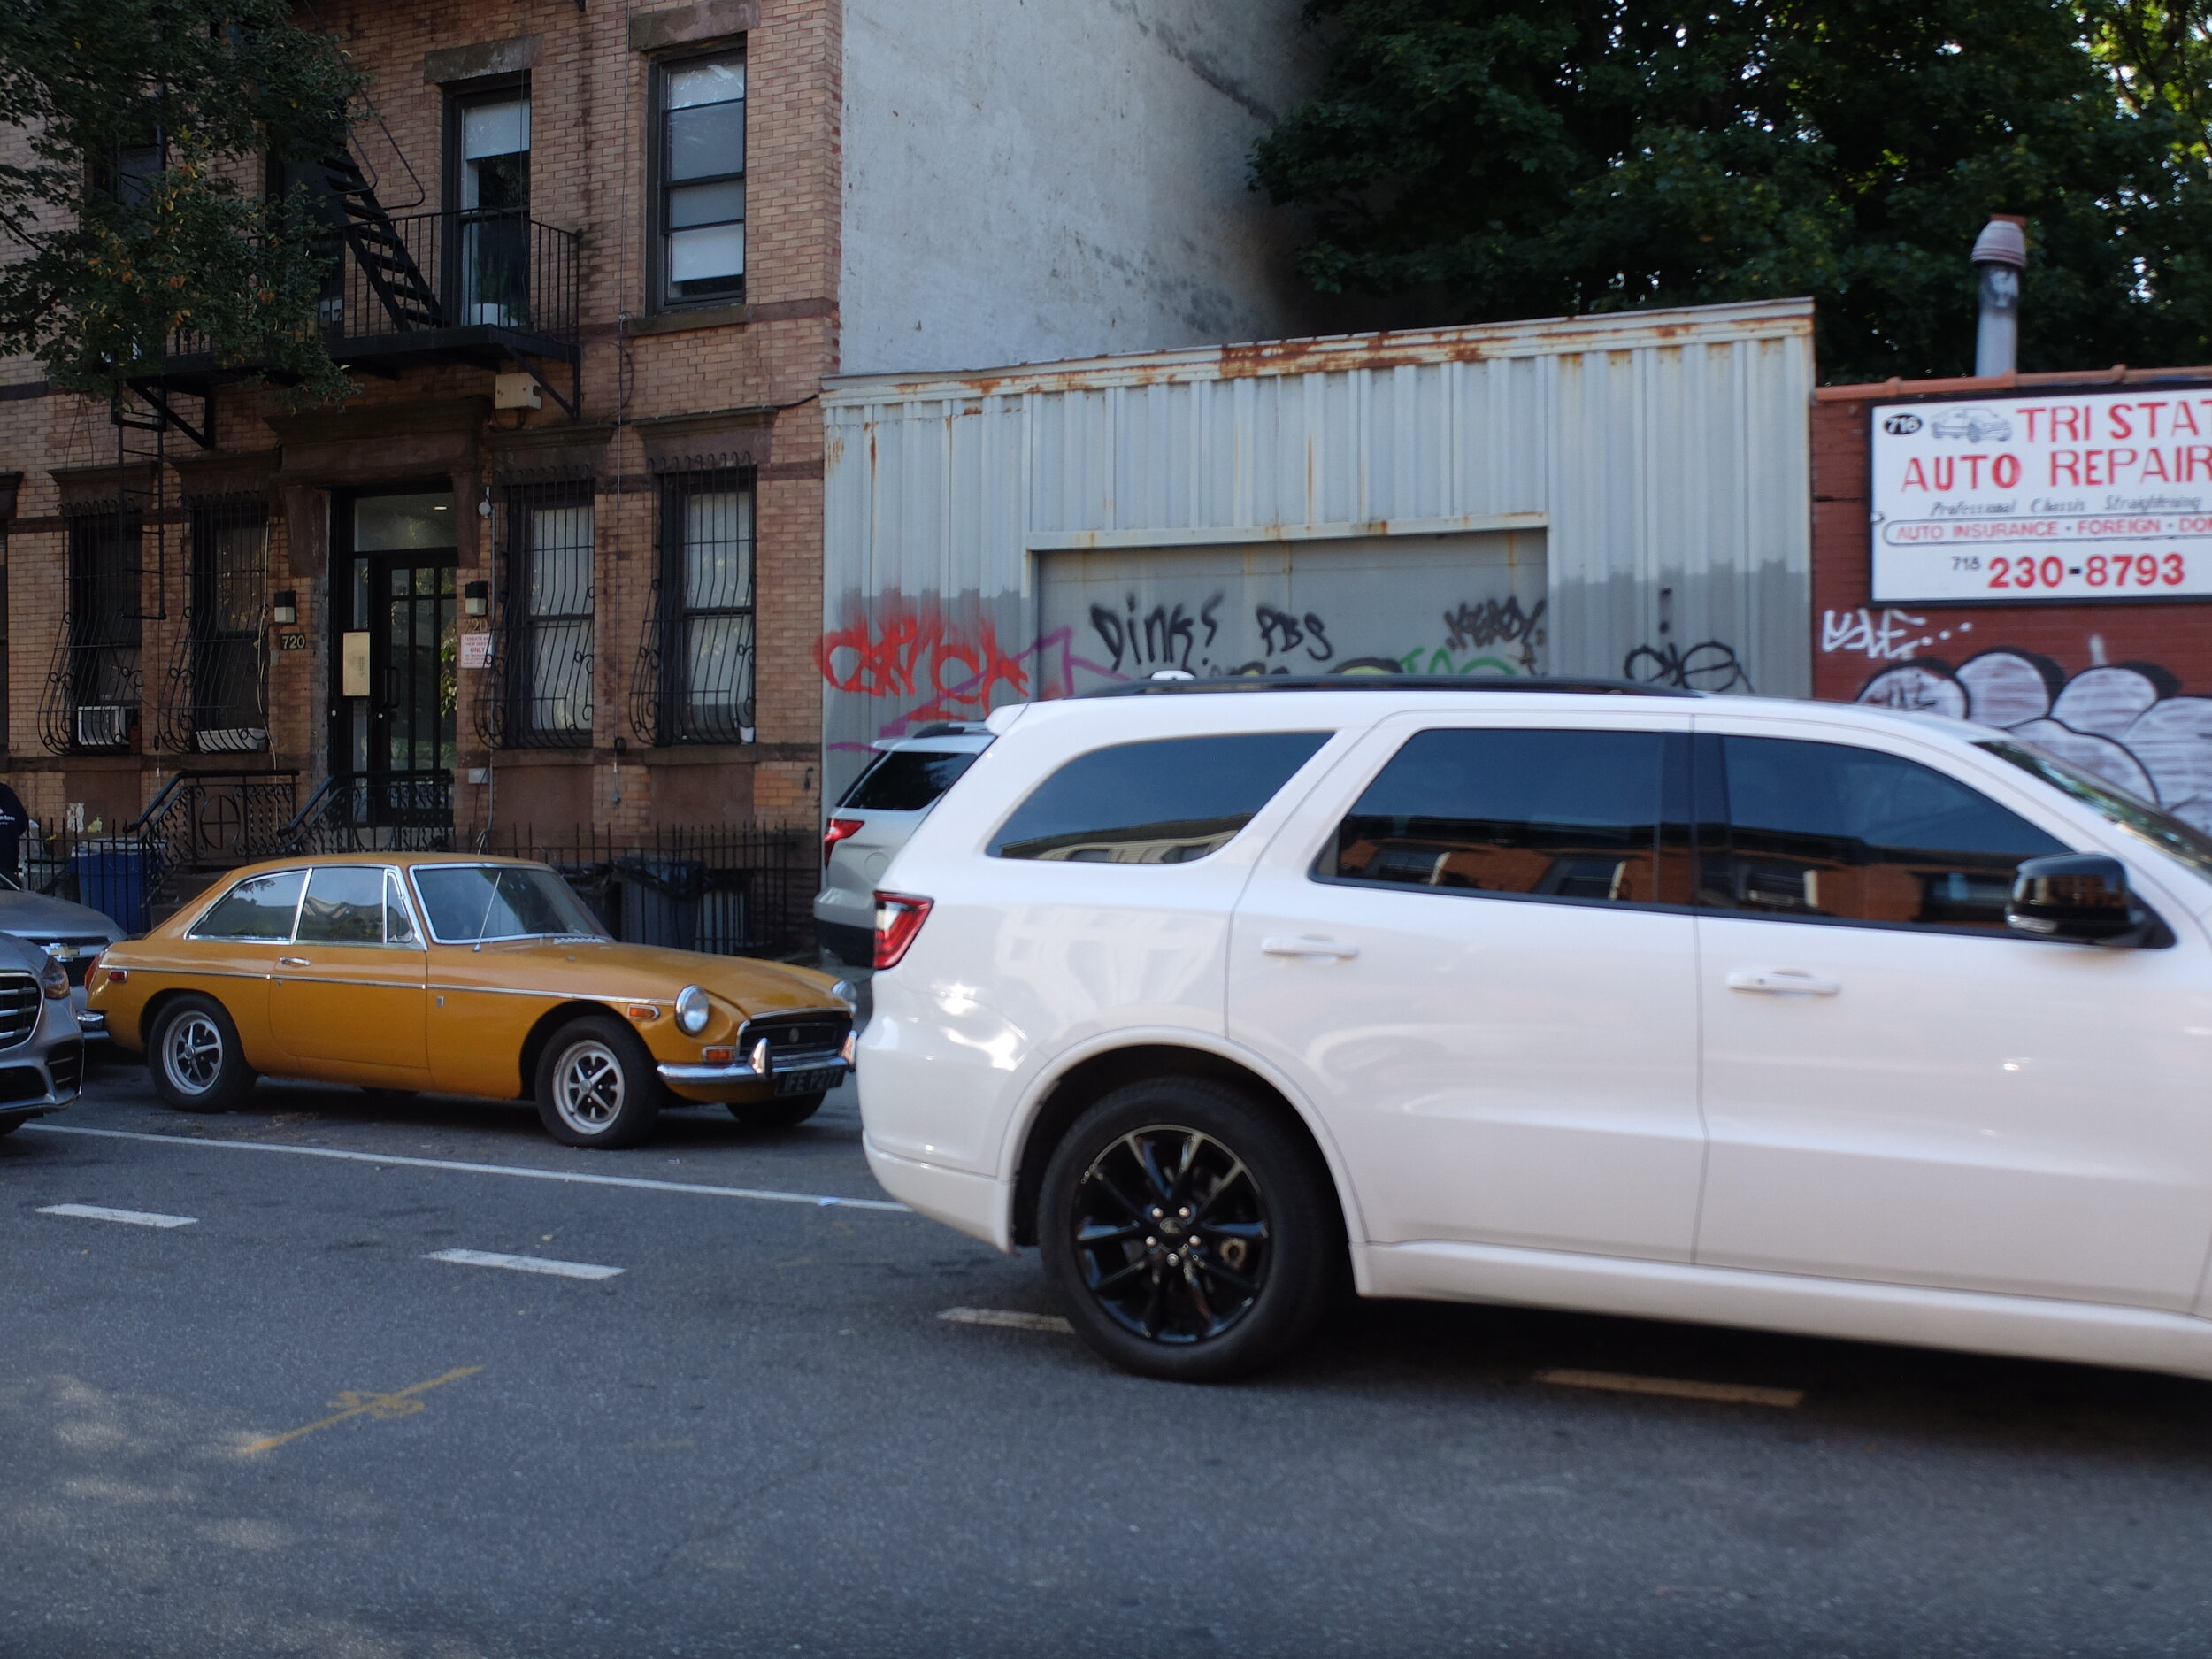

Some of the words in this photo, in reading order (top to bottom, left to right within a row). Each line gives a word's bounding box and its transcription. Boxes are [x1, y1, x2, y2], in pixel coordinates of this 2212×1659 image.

[2016, 405, 2090, 442] TRI
[1901, 453, 2023, 492] AUTO
[1930, 499, 2016, 516] Professional
[2031, 497, 2085, 513] Chassis
[2105, 494, 2201, 514] Straightening
[1897, 525, 1944, 541] AUTO
[1953, 521, 2058, 538] INSURANCE
[2077, 518, 2161, 535] FOREIGN
[1952, 556, 1981, 571] 718
[1988, 552, 2185, 588] 230-8793
[281, 634, 305, 649] 720
